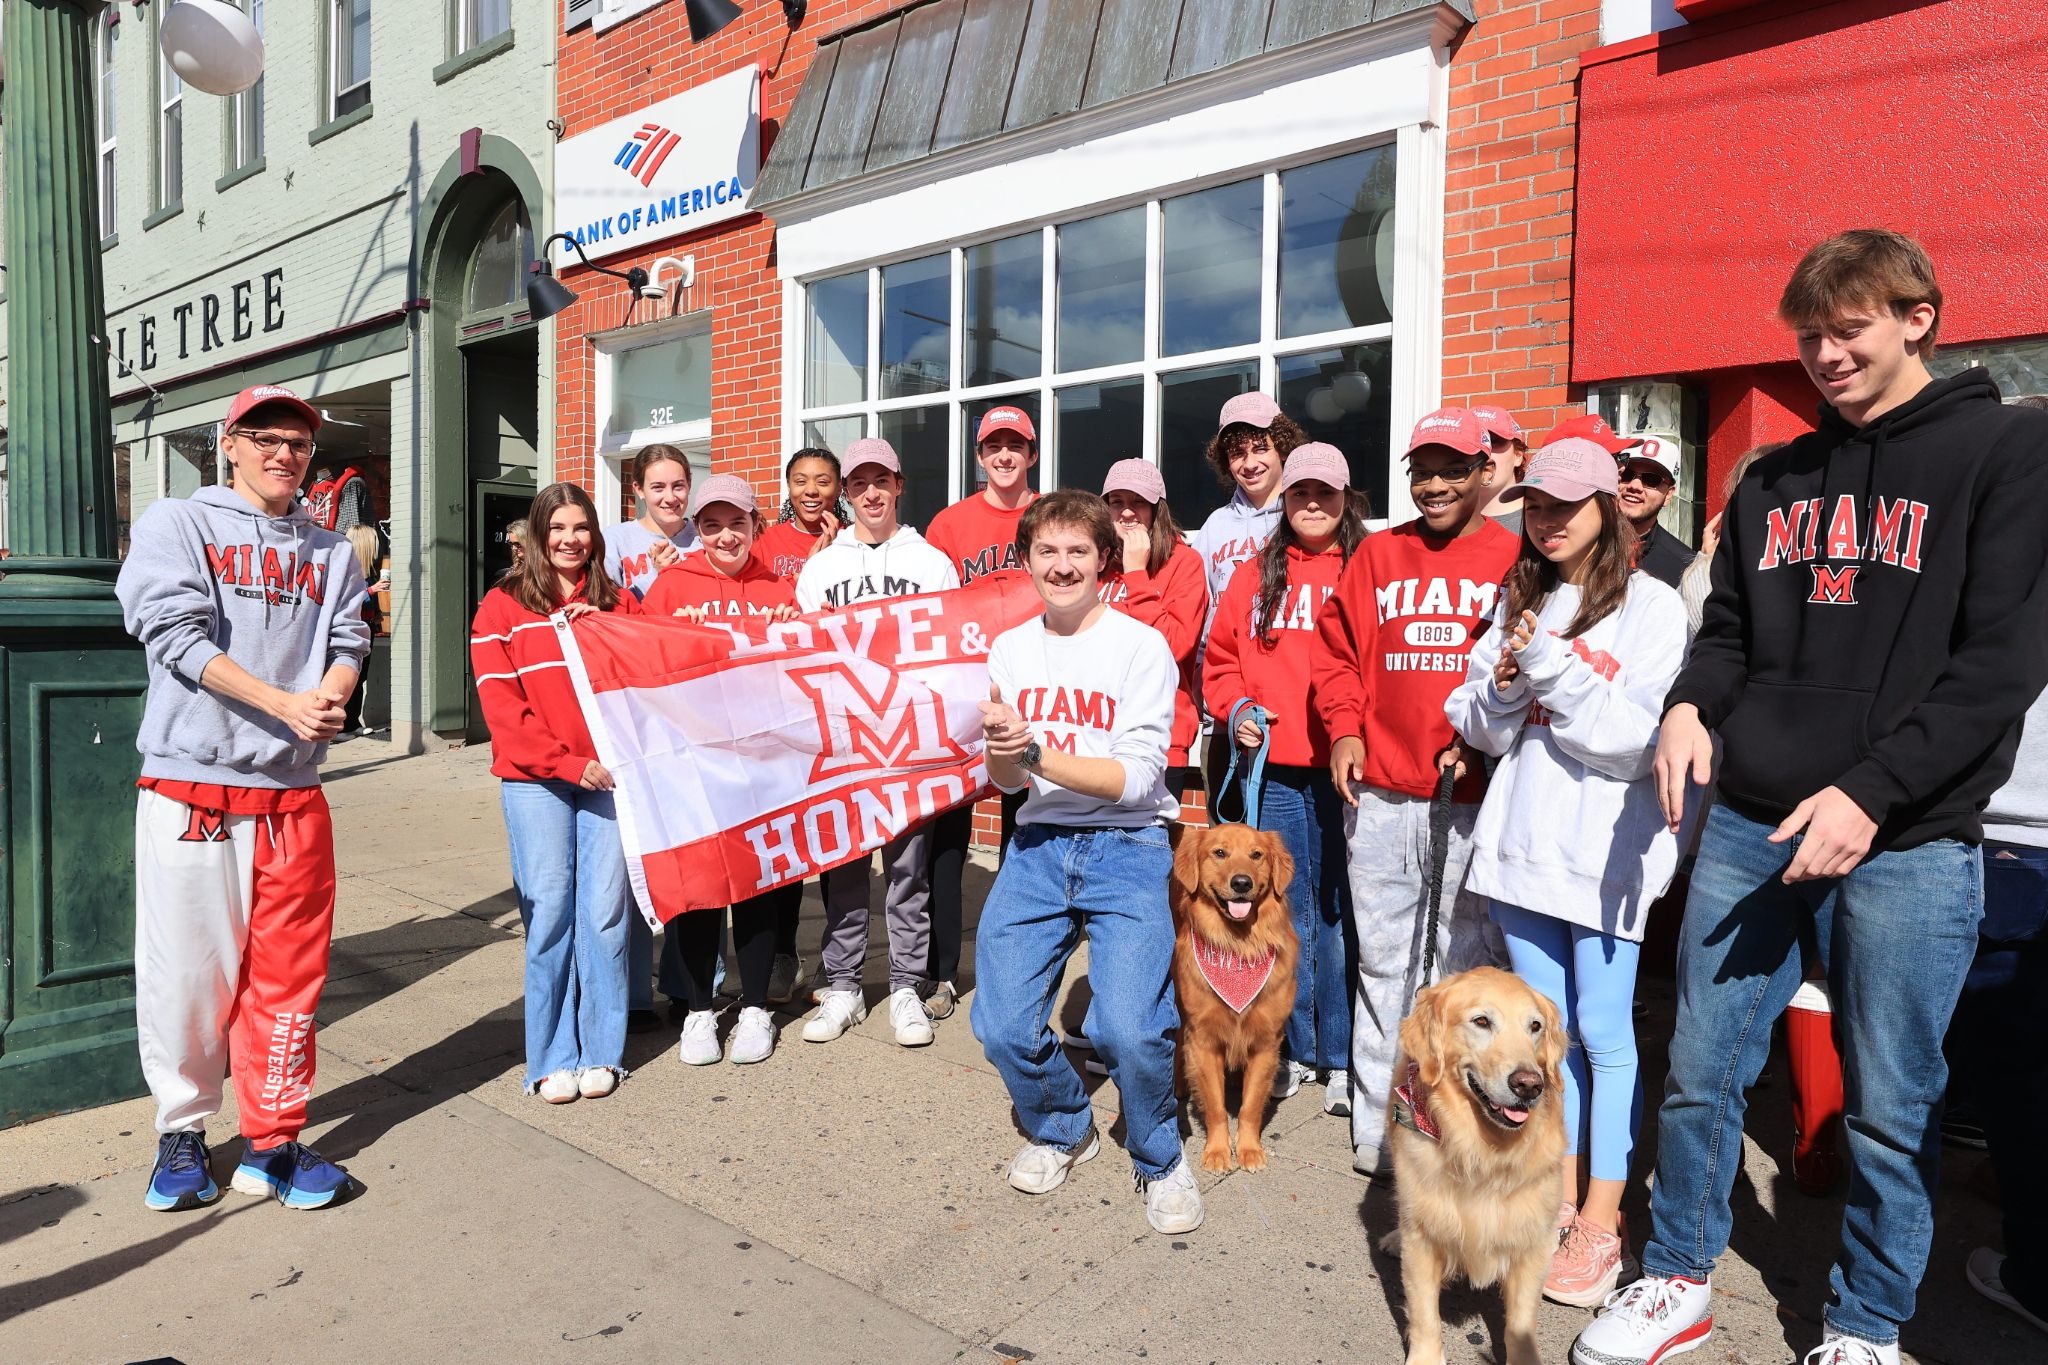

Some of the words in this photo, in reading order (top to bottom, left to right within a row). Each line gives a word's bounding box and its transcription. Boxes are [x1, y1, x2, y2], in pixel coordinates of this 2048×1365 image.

[564, 216, 613, 252] BANK
[617, 207, 642, 235] OF
[646, 176, 743, 227] AMERICA
[107, 315, 158, 379] LE
[173, 267, 285, 359] TREE
[650, 405, 674, 426] 32E
[1420, 415, 1462, 430] Miami
[1422, 427, 1462, 435] NIVERSITY
[1641, 439, 1661, 458] O
[1758, 494, 1929, 573] MIAMI
[962, 542, 1025, 586] MIA
[1211, 535, 1269, 574] MIA
[203, 542, 326, 607] MIAMI
[824, 574, 921, 607] MIAMI
[1807, 564, 1861, 604] M
[1375, 576, 1504, 628] MIAM
[959, 621, 991, 654] &
[1417, 625, 1453, 642] 1809
[260, 1012, 293, 1112] UNIVERSITY
